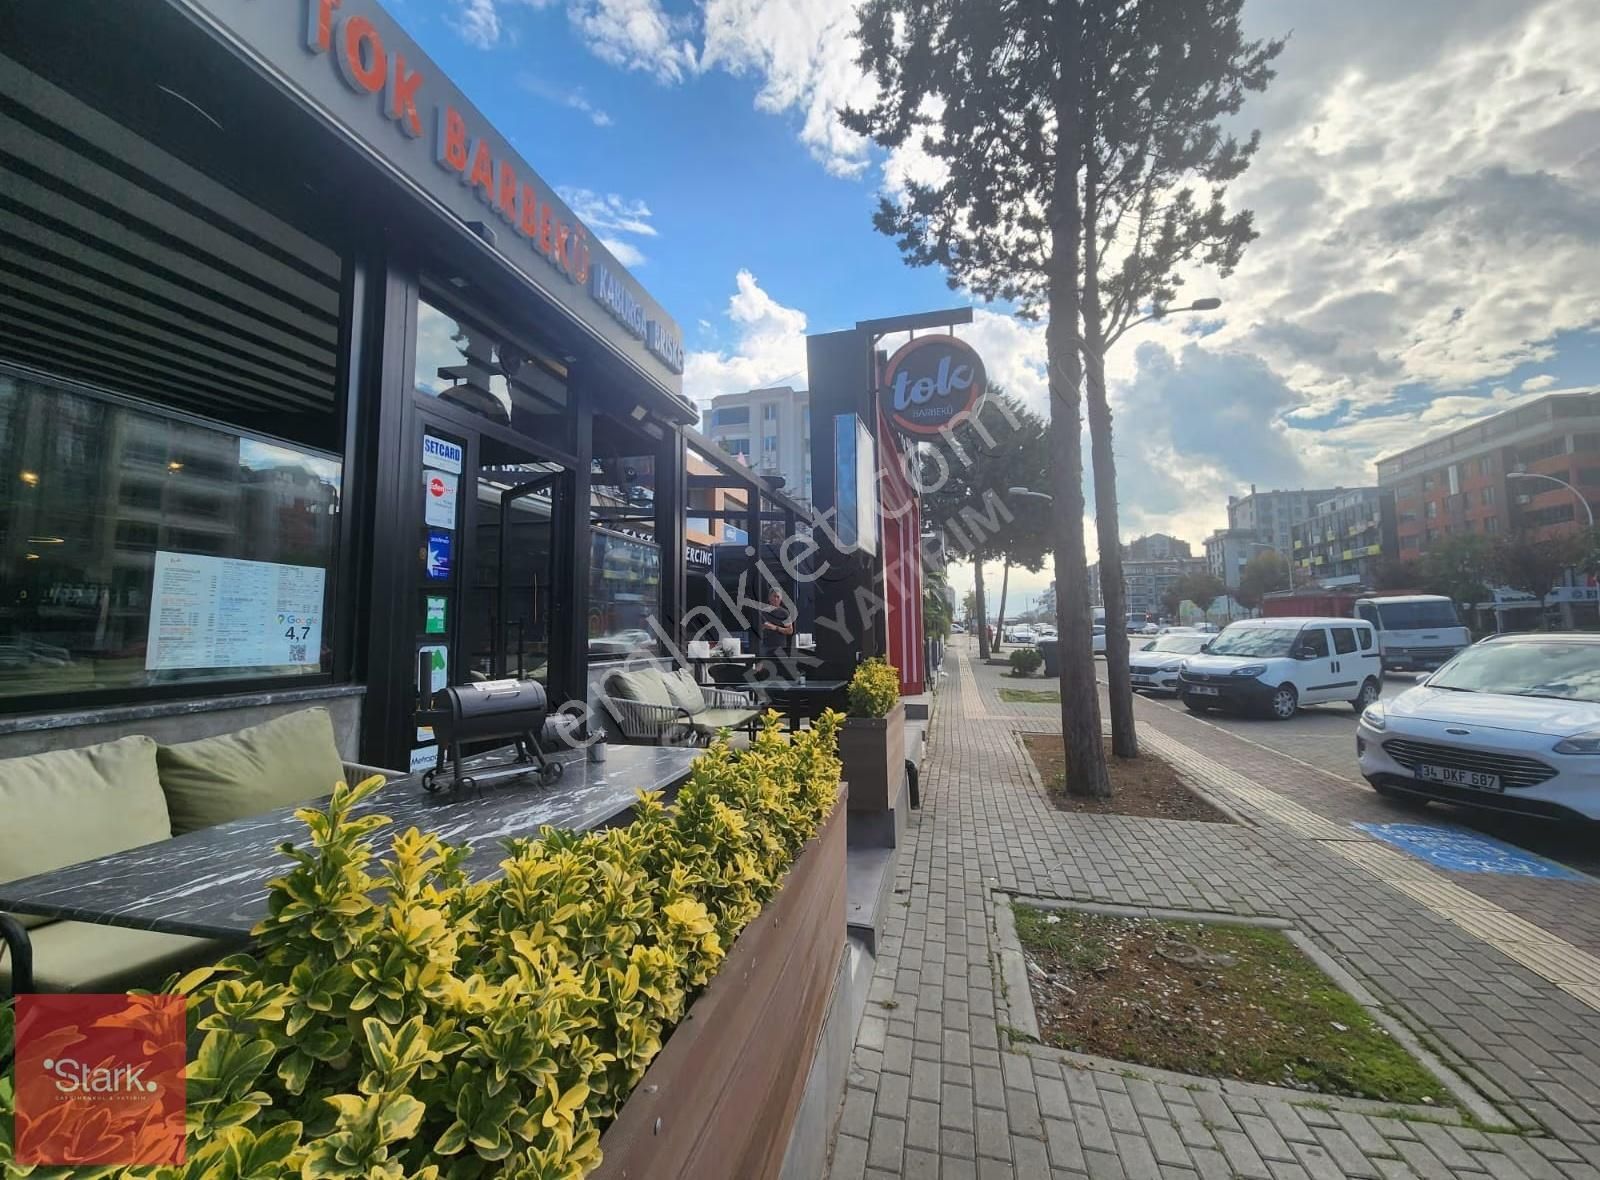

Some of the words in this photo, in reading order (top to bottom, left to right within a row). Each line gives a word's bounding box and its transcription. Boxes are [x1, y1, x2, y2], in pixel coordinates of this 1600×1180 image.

[437, 104, 592, 286] BARBEKÜ
[592, 263, 648, 341] KABURGA
[892, 356, 974, 410] tok
[912, 405, 954, 418] BARBEKÜ
[424, 438, 460, 462] SETCARD
[287, 614, 318, 626] Google
[285, 626, 311, 643] 4,7
[1423, 765, 1437, 778] 34
[1443, 768, 1466, 782] DKF
[1471, 773, 1496, 788] 687
